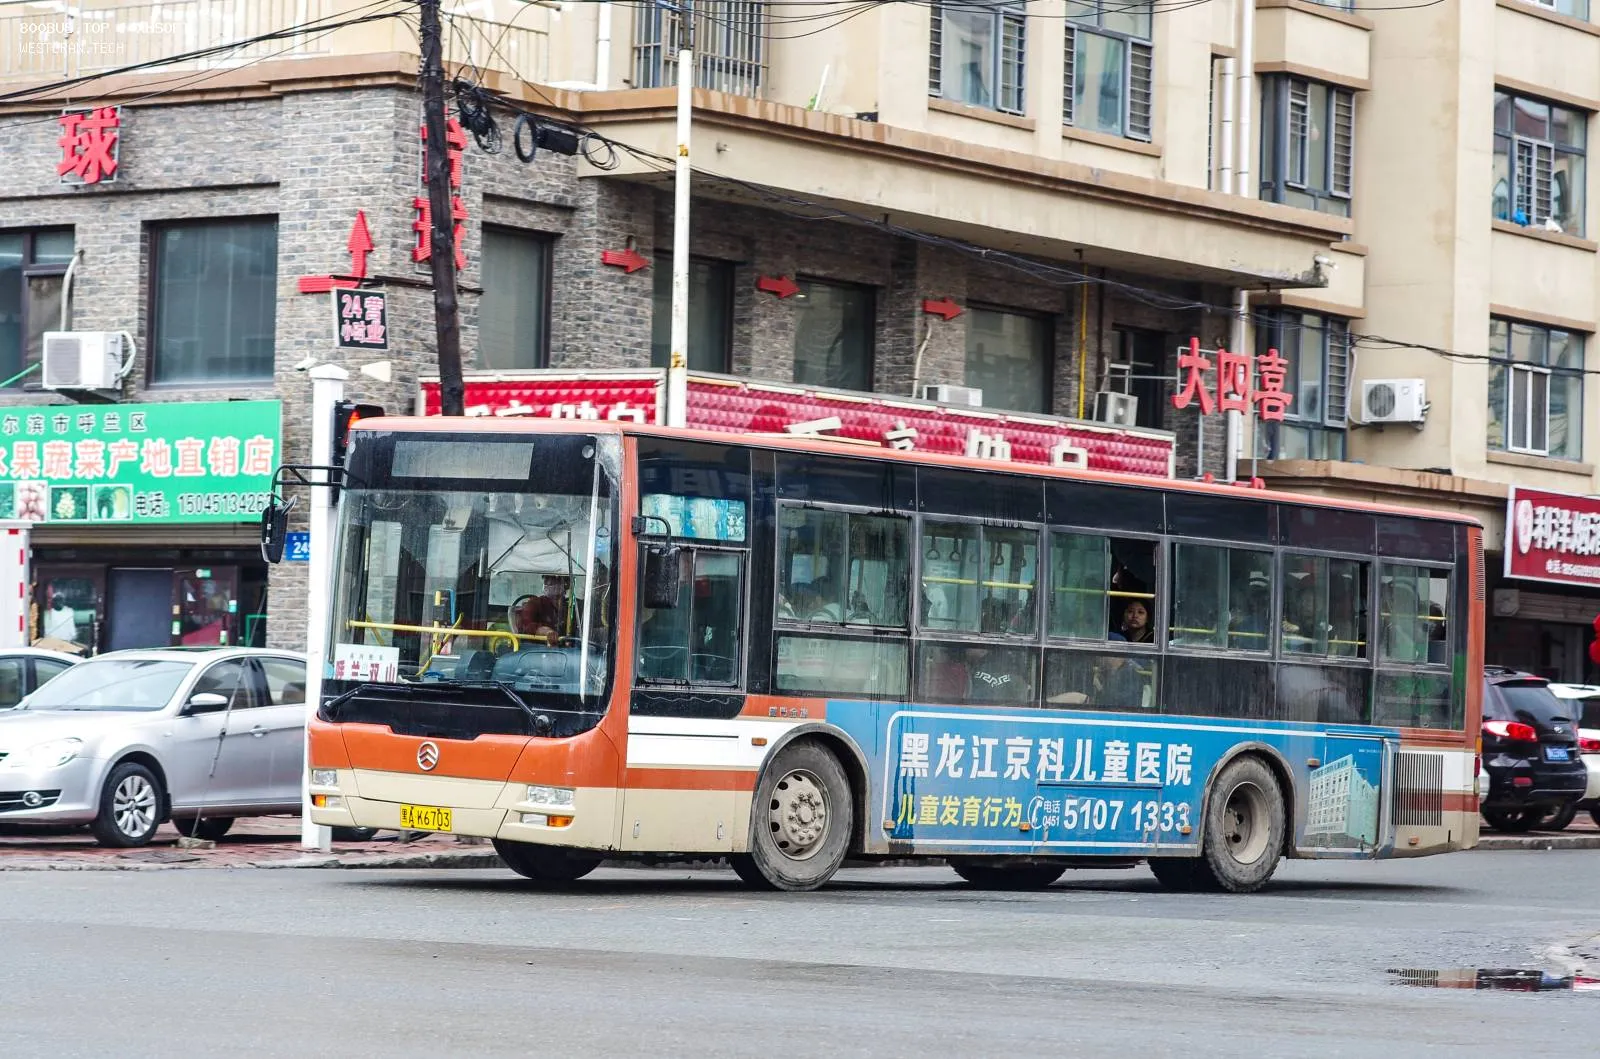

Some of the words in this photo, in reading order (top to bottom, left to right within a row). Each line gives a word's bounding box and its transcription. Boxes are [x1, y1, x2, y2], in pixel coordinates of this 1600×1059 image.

[57, 107, 120, 184] 球
[1171, 336, 1293, 422] 大四喜
[178, 490, 272, 516] 1504513426
[899, 732, 1193, 787] 黑龙江京科儿童医院
[897, 793, 1023, 828] 儿童发育行为
[1042, 815, 1060, 828] 0451
[1043, 800, 1061, 814] 电话
[1063, 799, 1125, 831] 5107
[1131, 801, 1191, 833] 1333
